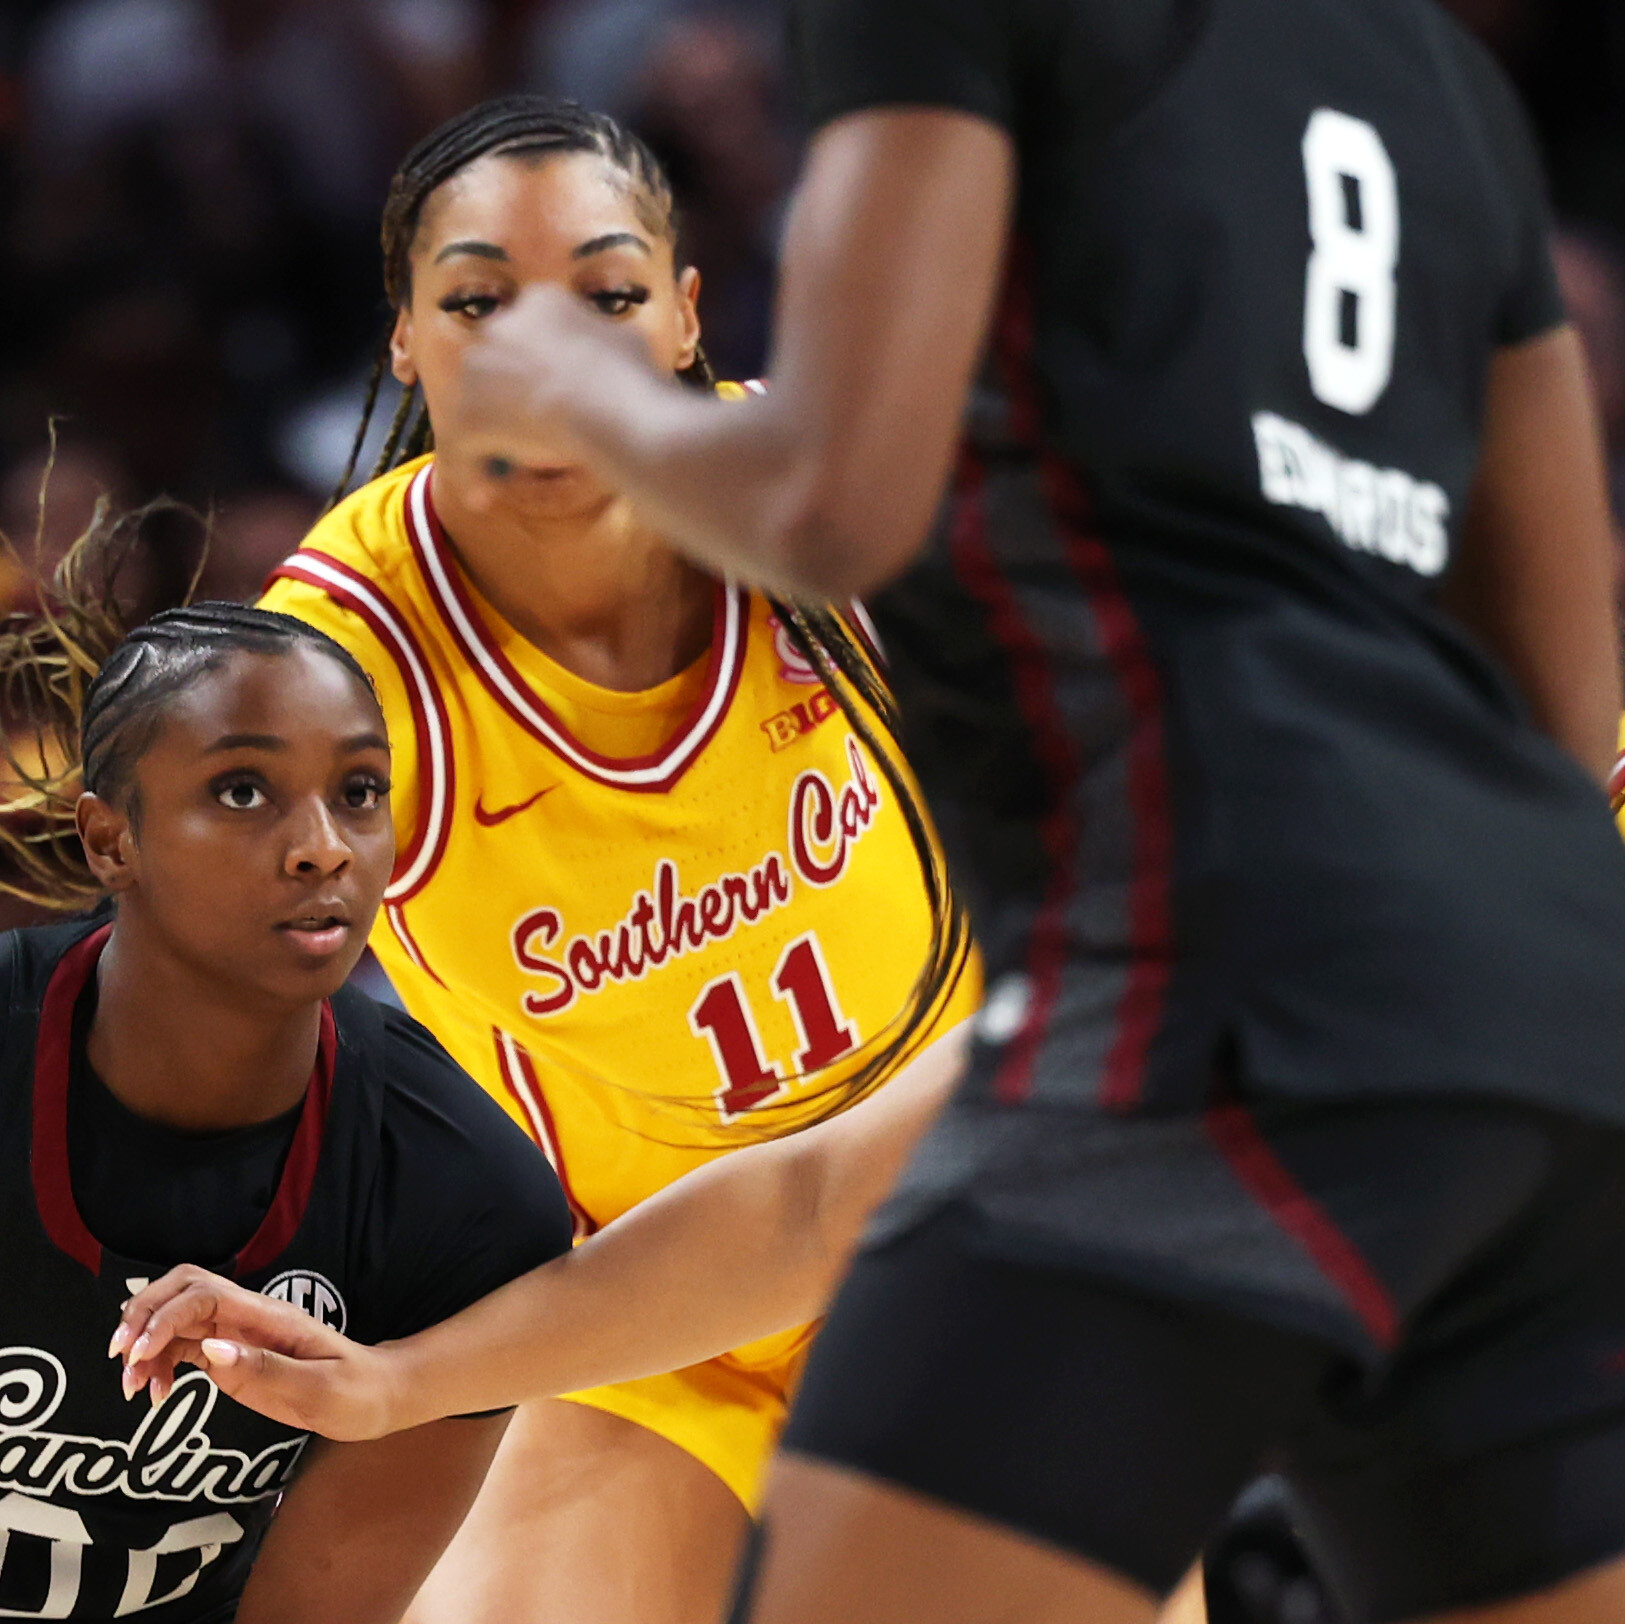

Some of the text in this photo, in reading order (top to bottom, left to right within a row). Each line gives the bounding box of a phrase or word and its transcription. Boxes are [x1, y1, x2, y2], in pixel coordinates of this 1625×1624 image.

[1301, 107, 1400, 415] 8
[511, 733, 881, 1017] Southern Cal
[686, 929, 860, 1126] 11
